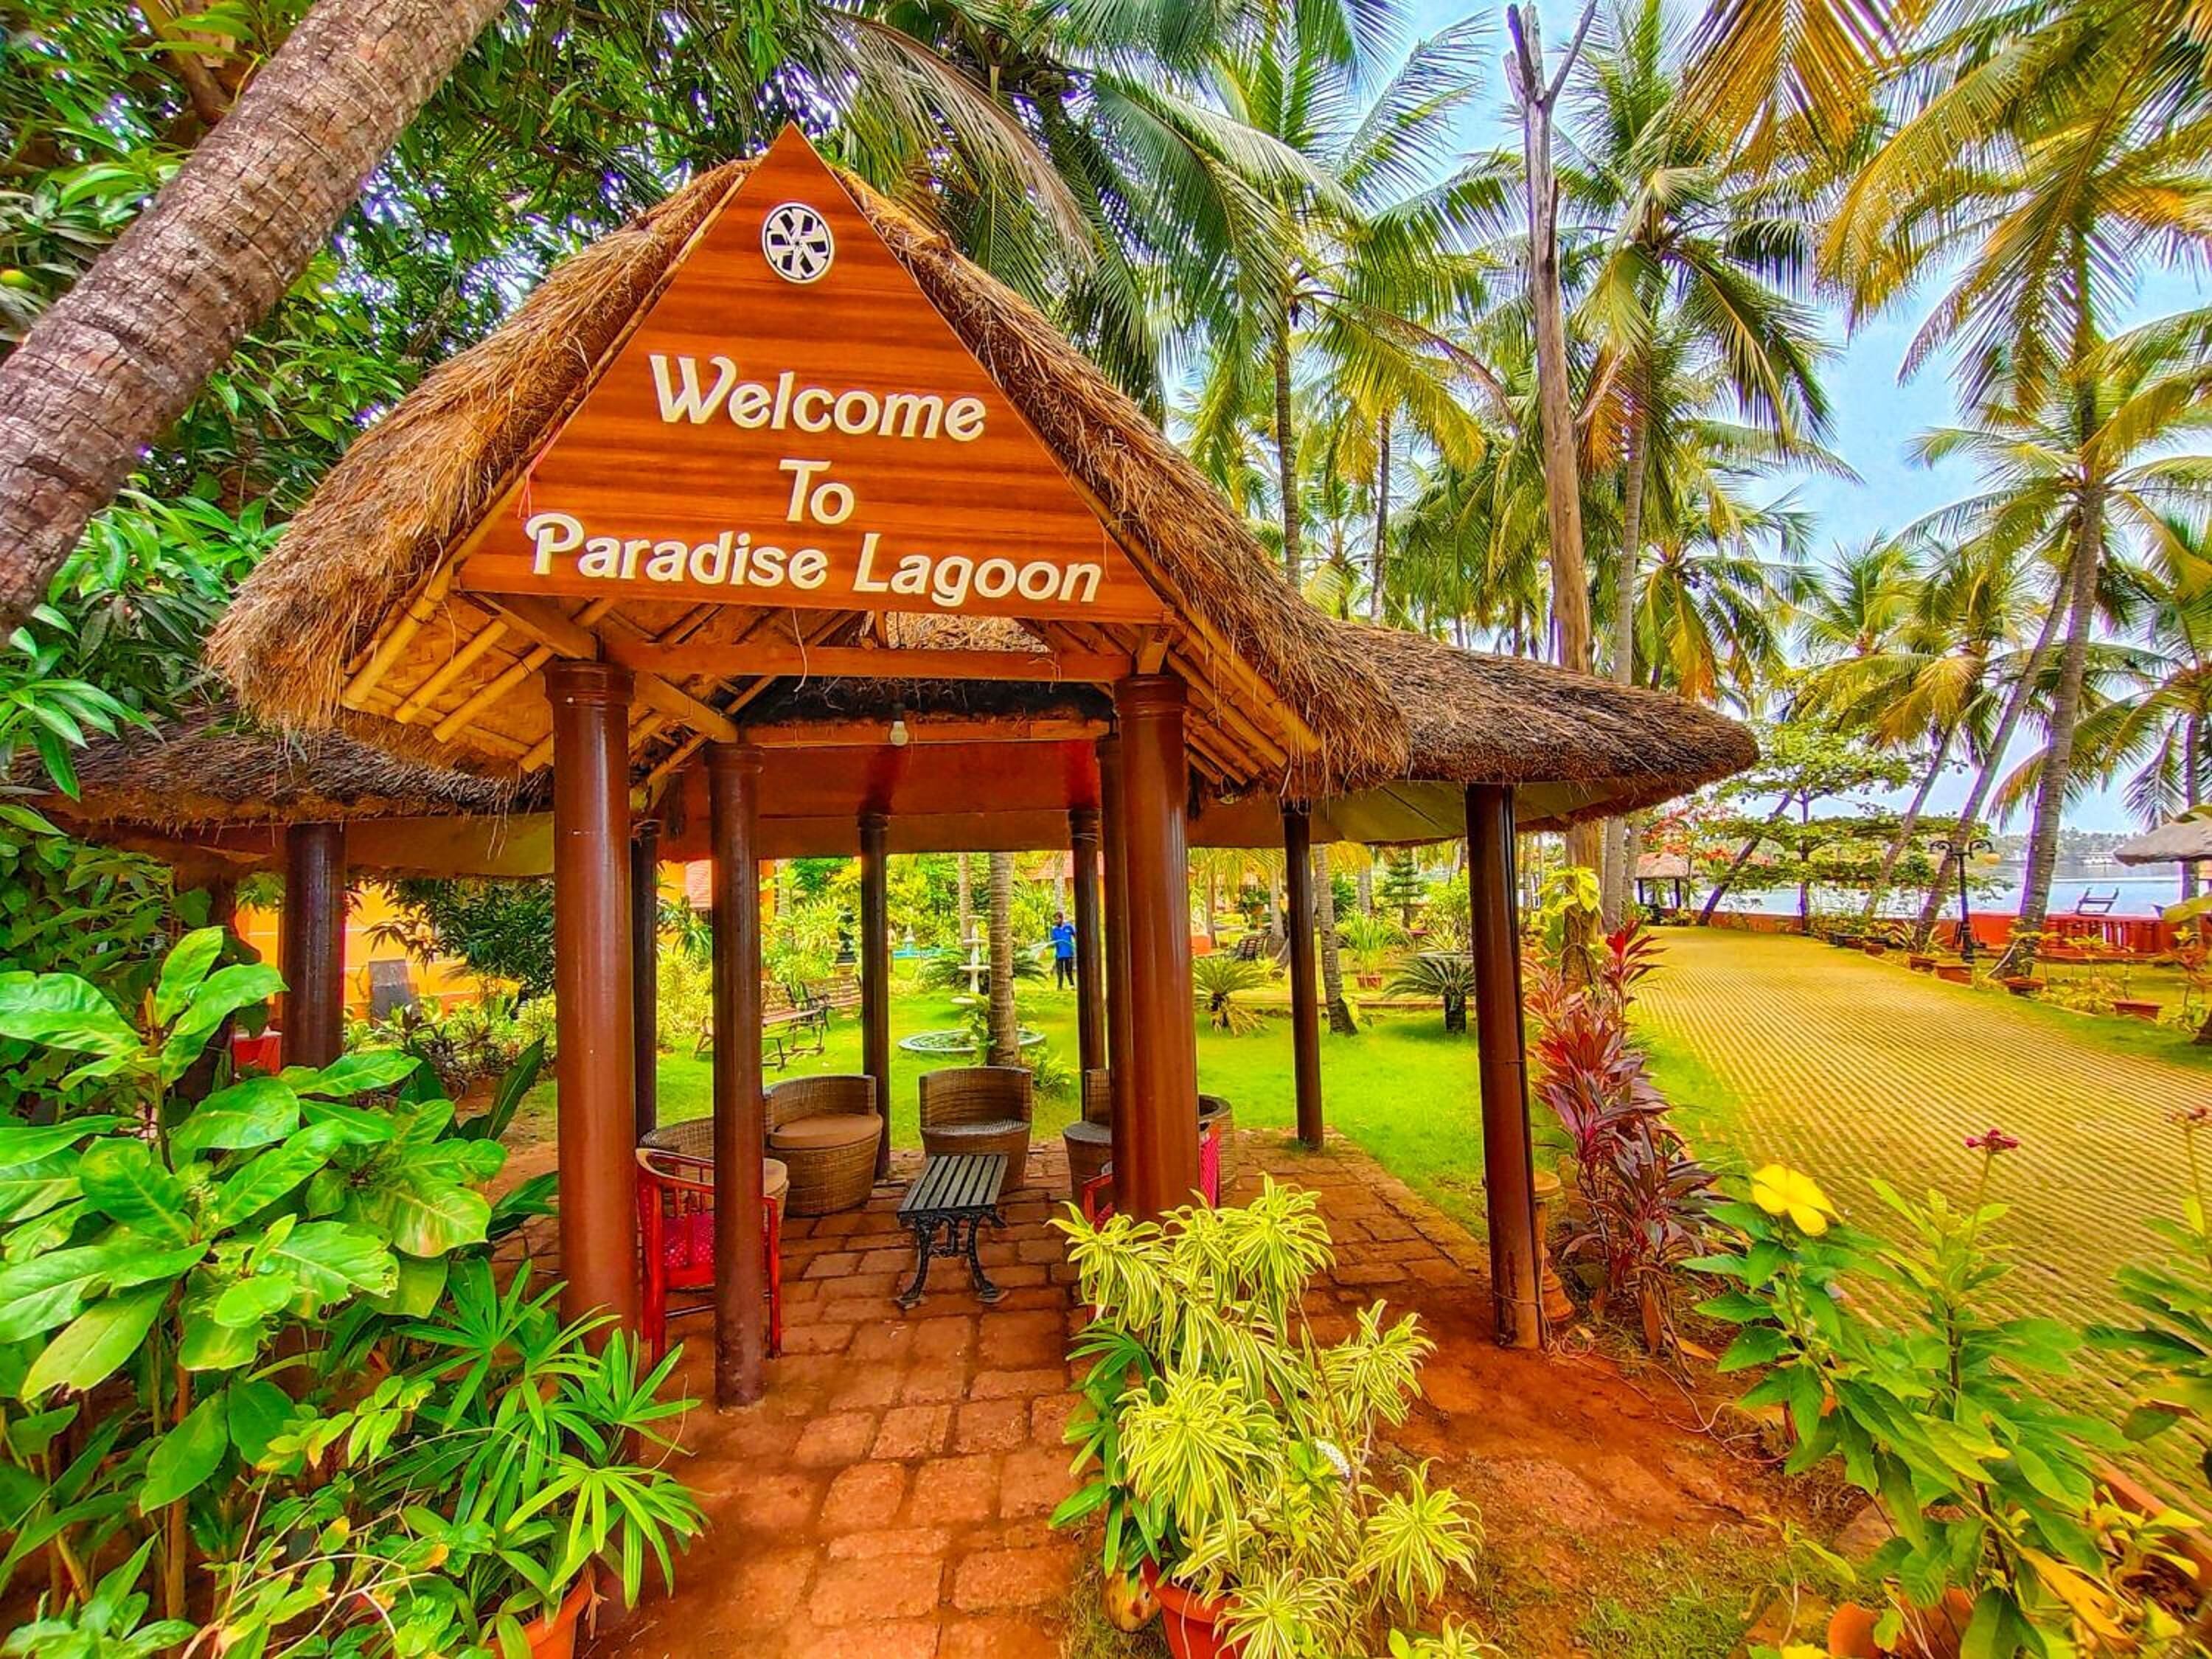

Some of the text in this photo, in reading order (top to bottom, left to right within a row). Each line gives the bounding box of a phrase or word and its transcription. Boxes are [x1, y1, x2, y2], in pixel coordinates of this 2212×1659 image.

[650, 354, 985, 442] Welcome
[779, 459, 855, 526] To
[525, 513, 1102, 607] Paradise Lagoon
